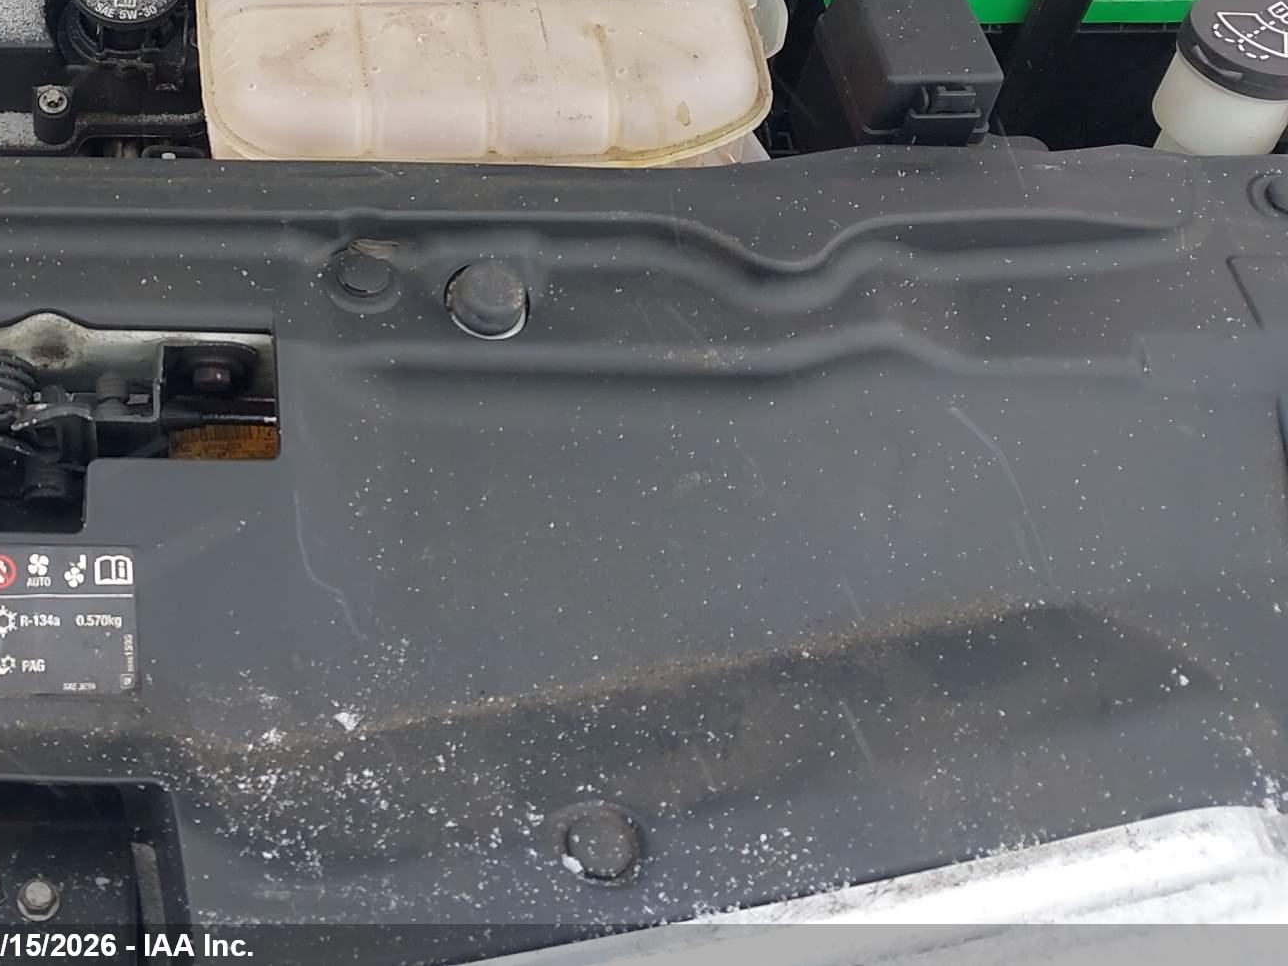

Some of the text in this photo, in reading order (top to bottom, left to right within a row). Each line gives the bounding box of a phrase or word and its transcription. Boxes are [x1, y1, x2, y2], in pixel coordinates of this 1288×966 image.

[94, 2, 157, 20] SAE 5W-30
[26, 576, 52, 588] AUTO
[19, 614, 122, 628] R-134a 0.570kg
[22, 659, 46, 672] PAG
